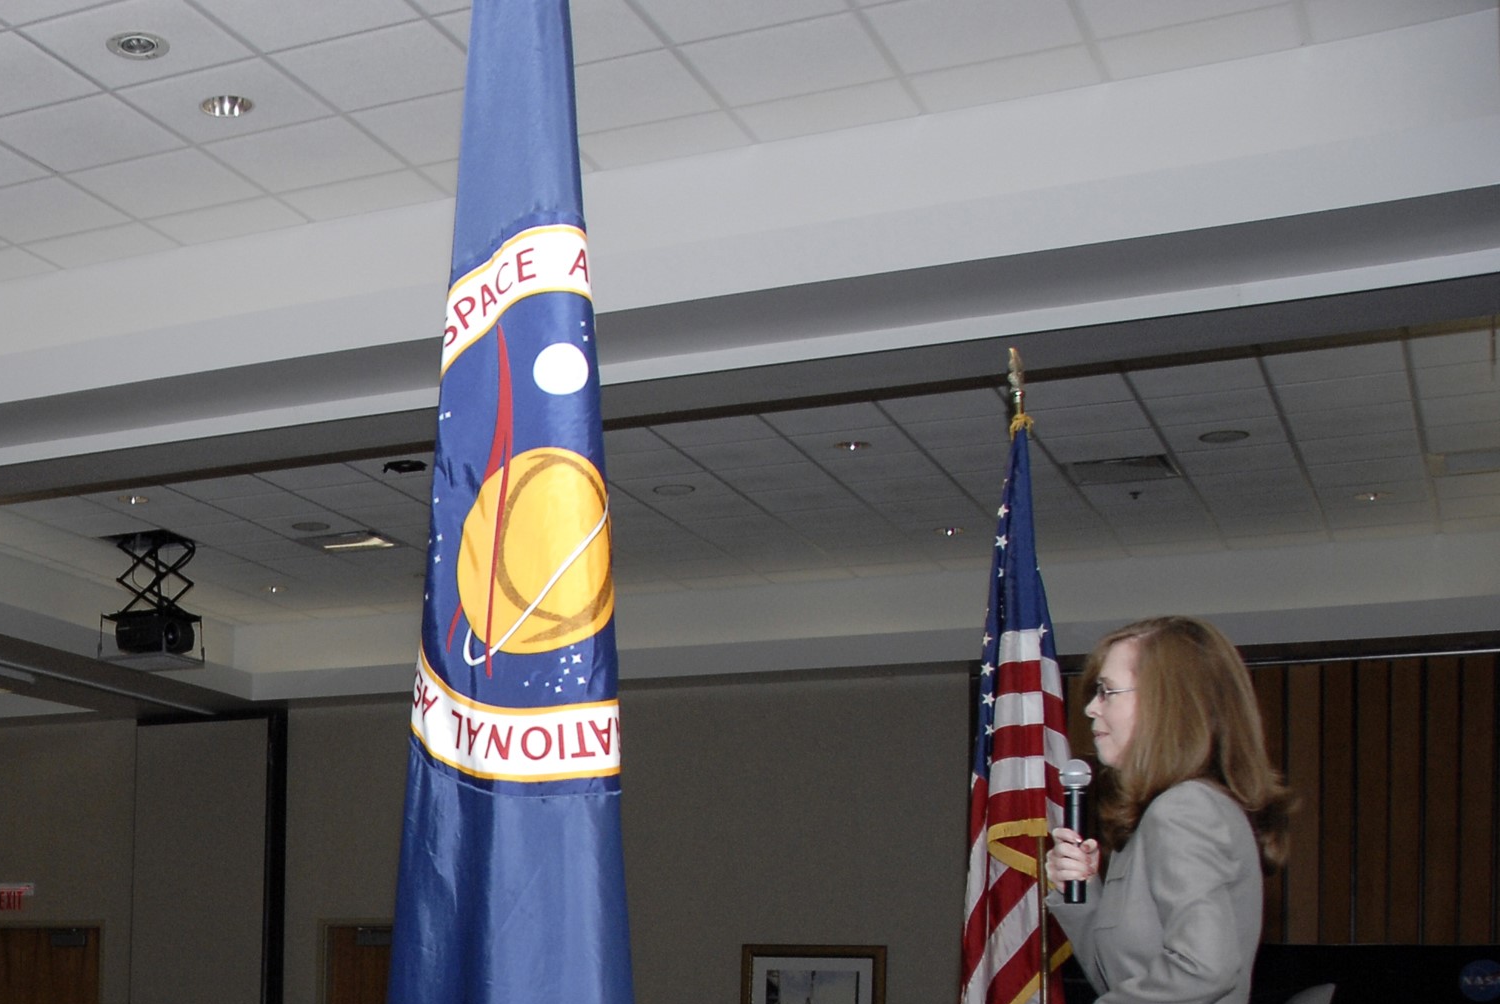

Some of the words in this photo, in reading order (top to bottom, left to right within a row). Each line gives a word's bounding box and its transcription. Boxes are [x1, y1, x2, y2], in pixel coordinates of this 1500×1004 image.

[444, 247, 537, 347] SPACE
[451, 709, 620, 760] ATIONAL
[0, 890, 24, 910] EXIT
